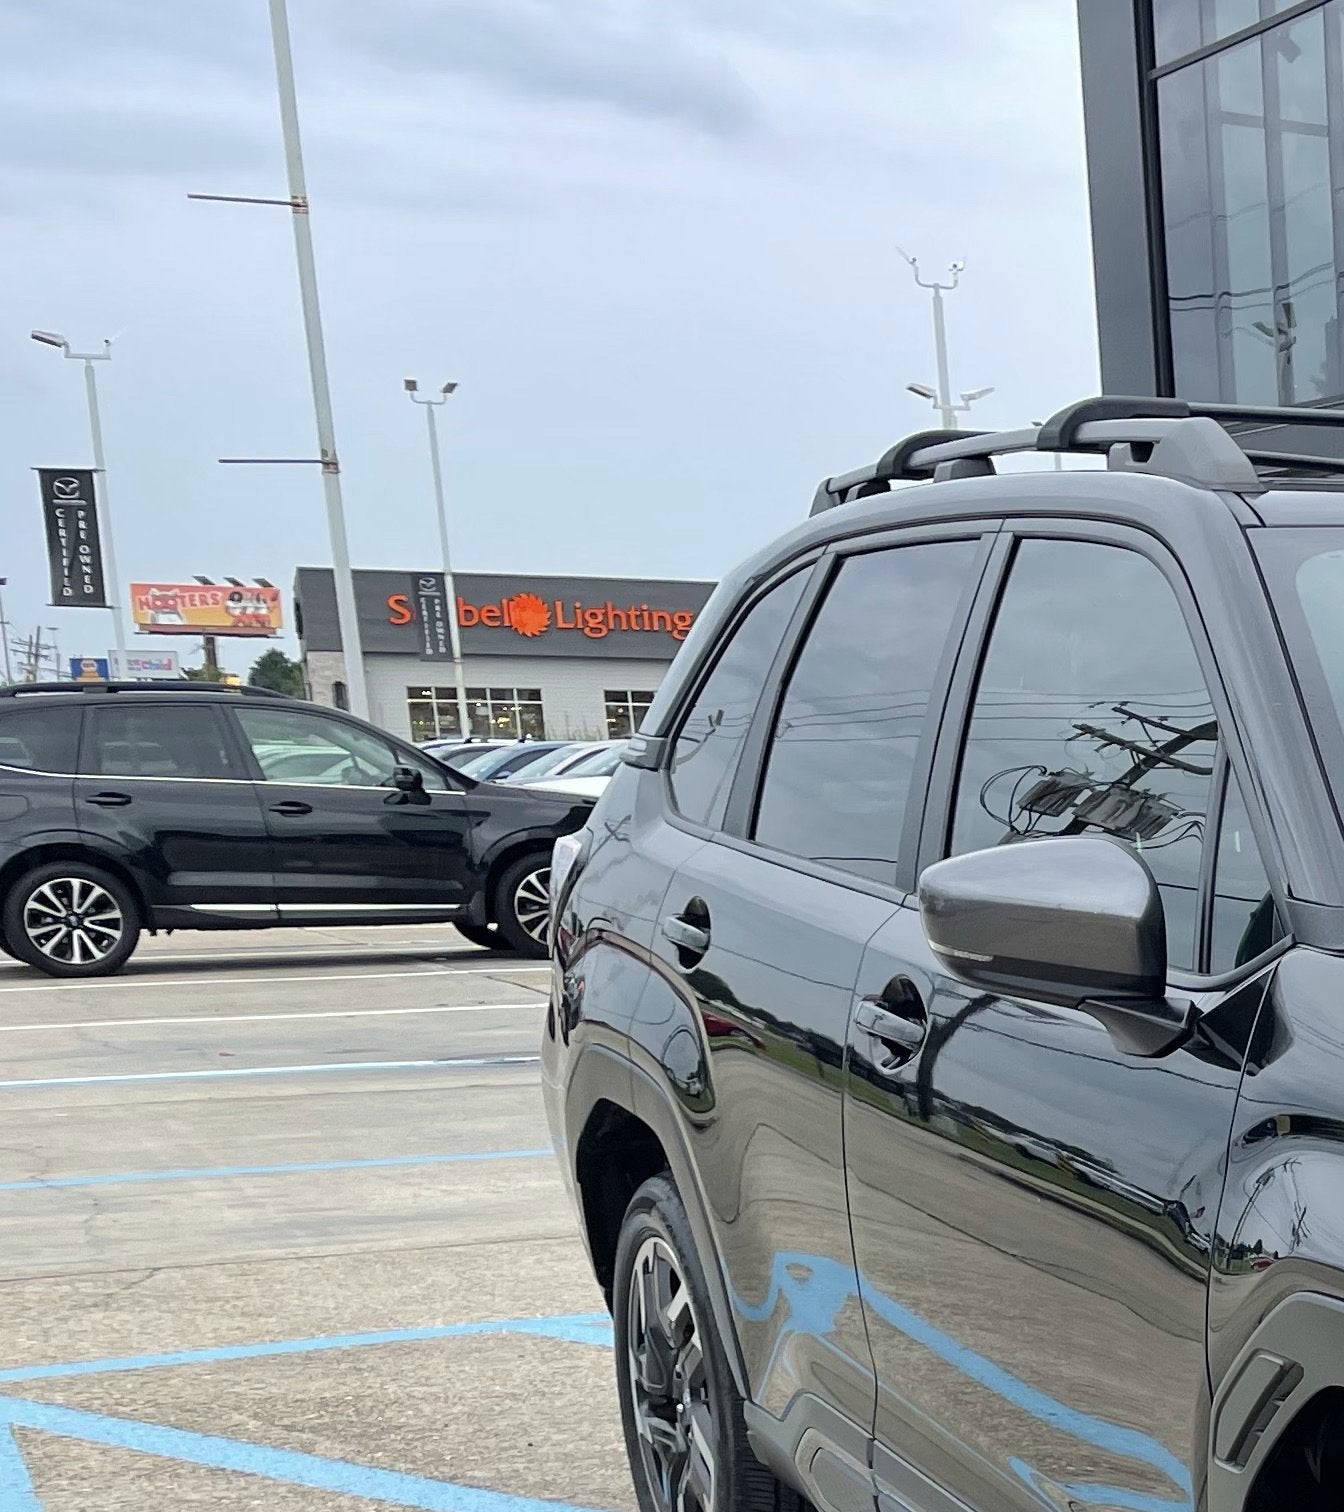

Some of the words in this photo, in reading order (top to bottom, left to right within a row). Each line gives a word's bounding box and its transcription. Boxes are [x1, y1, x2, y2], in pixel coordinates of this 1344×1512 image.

[77, 509, 87, 540] PRE
[55, 508, 73, 597] CERTIFIED
[79, 544, 94, 594] OWNED
[555, 599, 694, 640] Lighting
